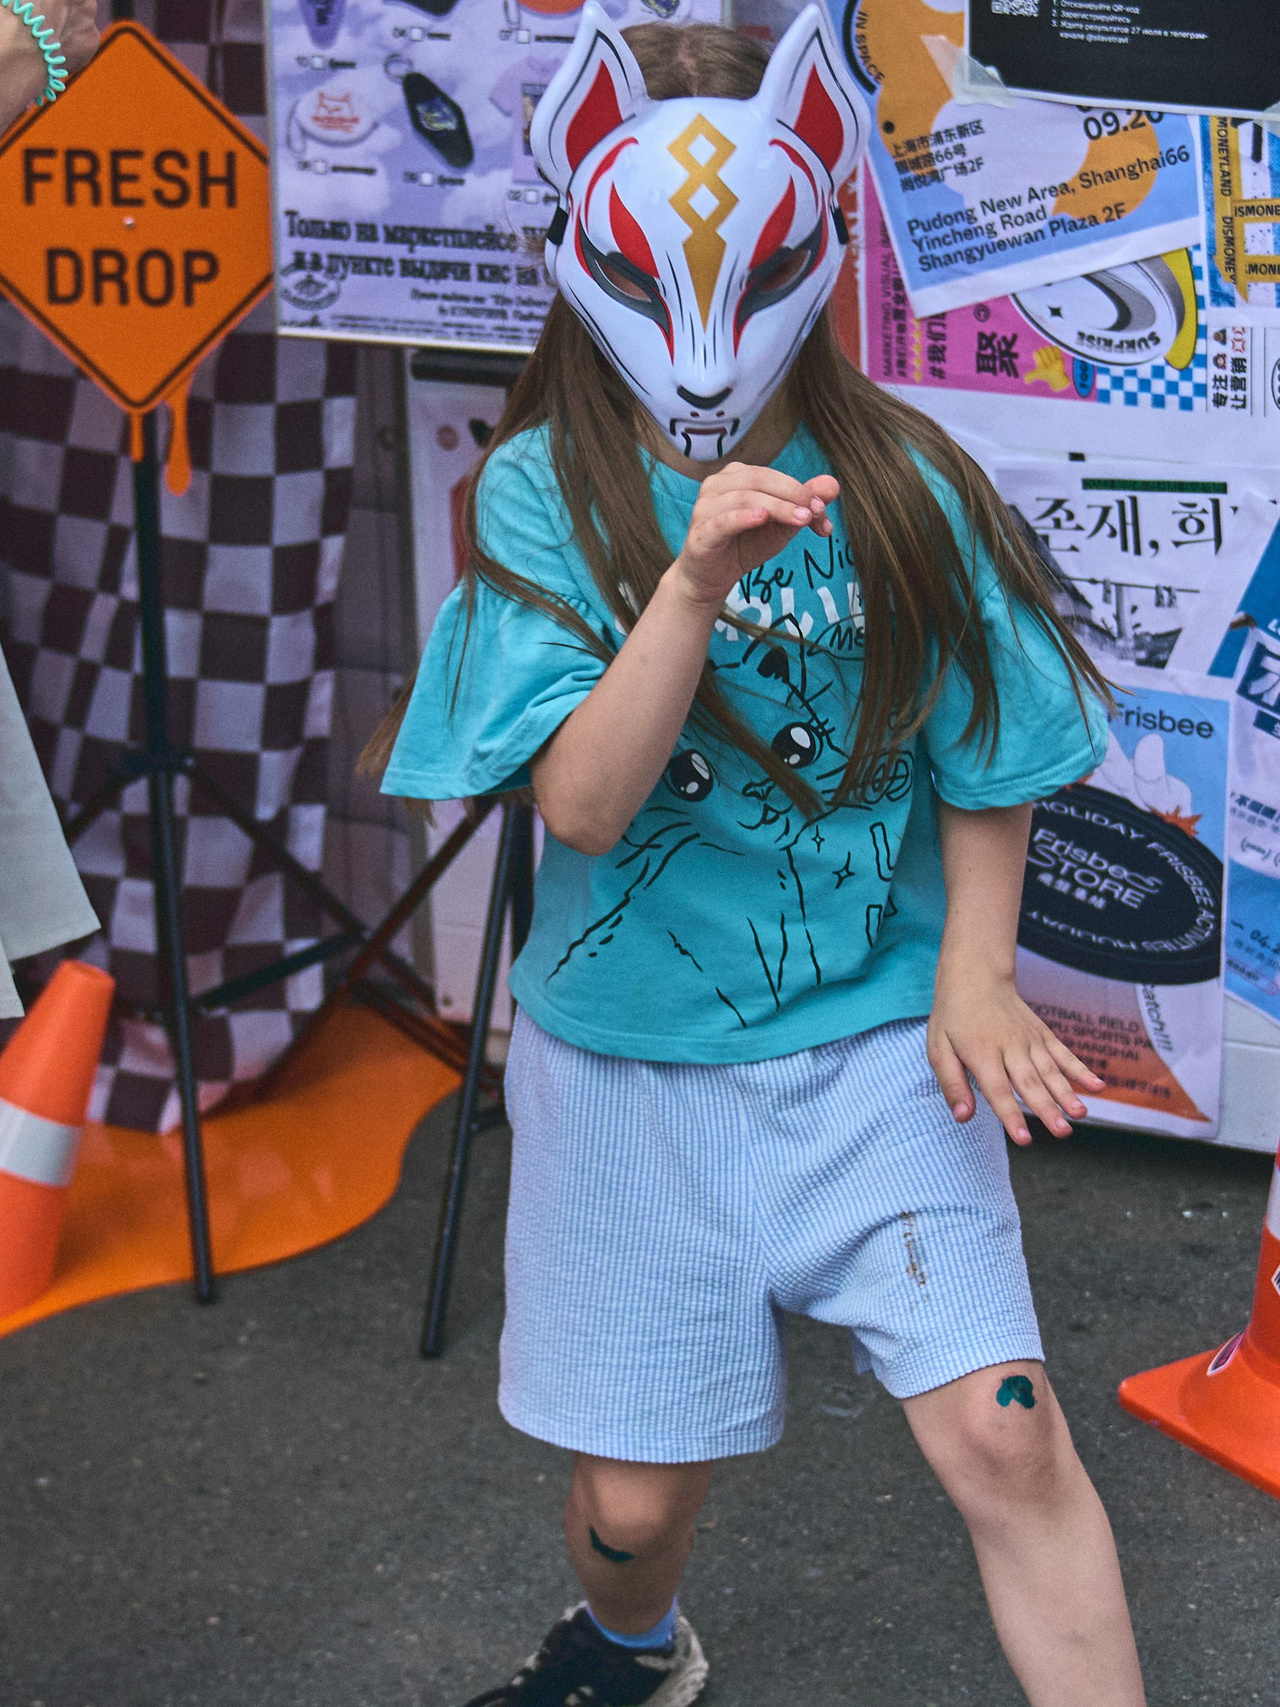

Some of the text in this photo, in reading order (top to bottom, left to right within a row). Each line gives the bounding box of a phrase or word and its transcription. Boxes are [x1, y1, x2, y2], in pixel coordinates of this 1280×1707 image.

[1112, 4, 1140, 15] QR-код
[22, 149, 238, 208] FRESH
[907, 207, 978, 237] Pudong
[980, 195, 1022, 216] New
[1027, 181, 1076, 203] Area,
[1078, 145, 1190, 189] Shanghai66
[284, 210, 350, 241] Только
[355, 223, 378, 243] на
[912, 221, 998, 253] Yincheng
[1000, 204, 1047, 230] Road
[918, 227, 1045, 272] Shangyuewan
[1048, 213, 1100, 237] Plaza
[1101, 201, 1126, 223] 2F
[46, 248, 219, 308] DROP
[326, 253, 394, 282] пункте
[976, 330, 1019, 378] 聚
[1076, 331, 1162, 354] SURPRISE
[1212, 374, 1228, 408] 专注
[1230, 357, 1247, 410] 让营销
[740, 563, 794, 604] Be
[1108, 703, 1214, 739] Frisbee
[1027, 842, 1147, 910] STORE
[1146, 841, 1215, 908] FRISBEE
[1098, 1014, 1139, 1033] FIELD
